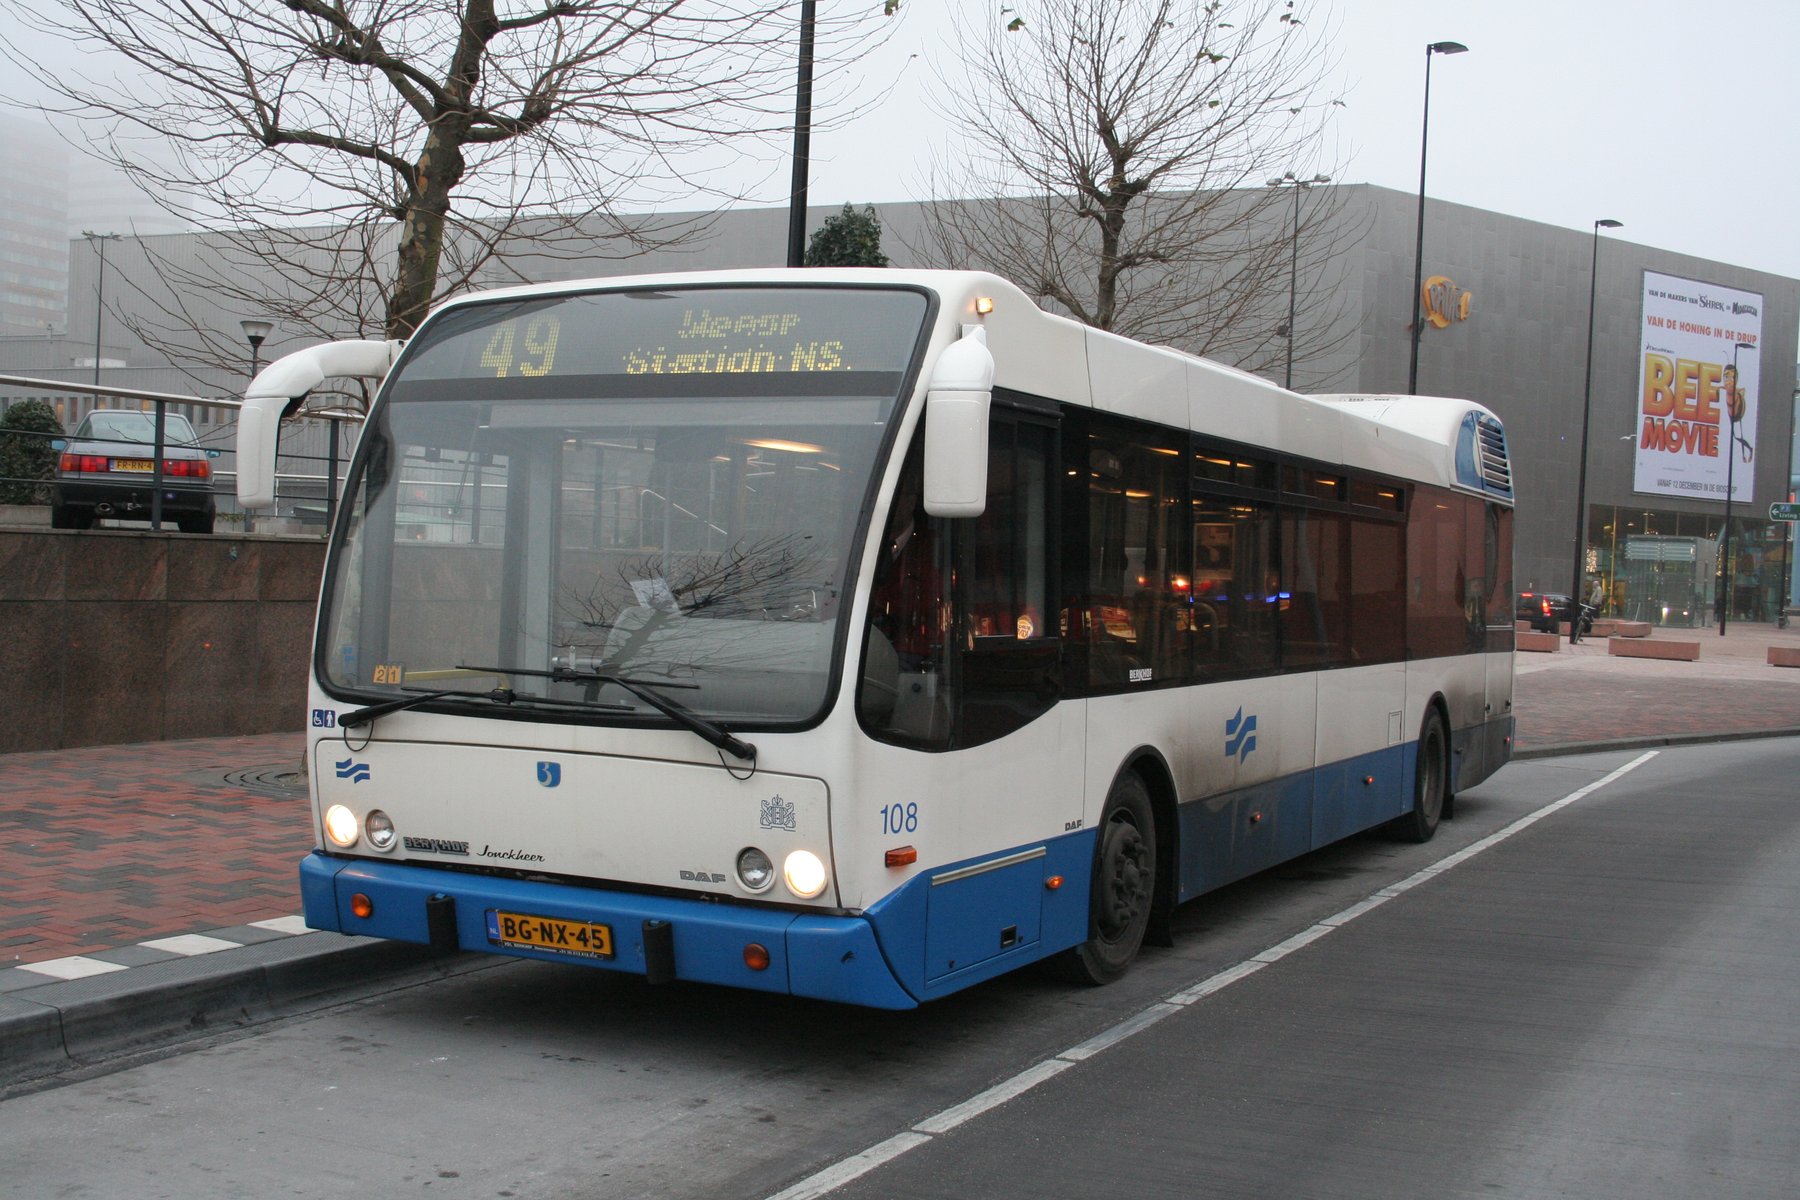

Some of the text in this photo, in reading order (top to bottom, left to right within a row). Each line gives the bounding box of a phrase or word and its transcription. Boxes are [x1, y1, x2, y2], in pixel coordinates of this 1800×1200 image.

[1647, 315, 1758, 344] VAN DE HONING IN DE DRUP
[480, 313, 561, 378] 49
[625, 341, 843, 375] Station NS
[1642, 352, 1723, 425] BEE
[1640, 416, 1720, 458] MOVIE
[116, 460, 154, 471] FR-RN-4
[1657, 479, 1672, 487] VANAF
[1673, 480, 1678, 488] 12
[1679, 481, 1703, 491] DECEMBER
[1709, 484, 1715, 492] DE
[880, 801, 918, 835] 108
[1064, 819, 1083, 832] DAF
[403, 836, 470, 855] BERKHOF
[679, 870, 727, 884] DAF
[503, 917, 605, 949] BG-NX-45
